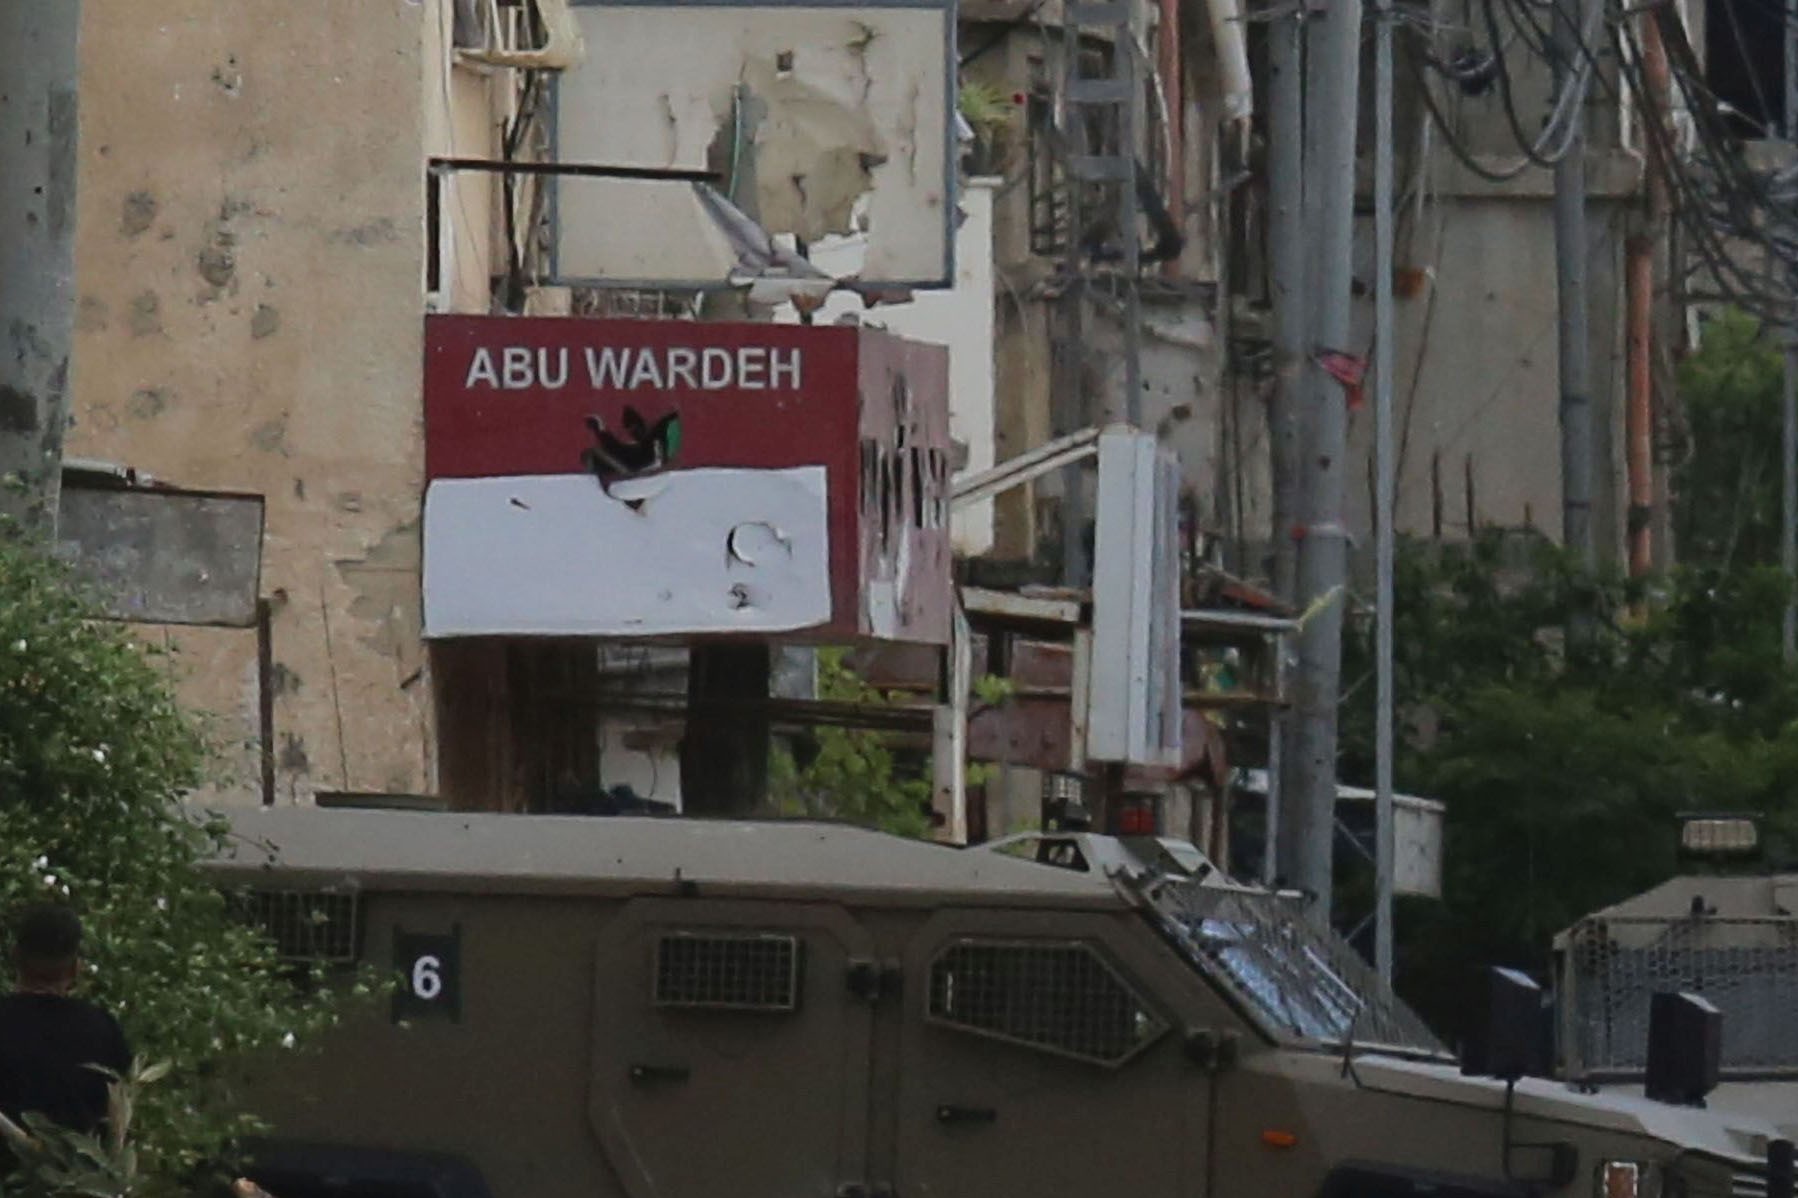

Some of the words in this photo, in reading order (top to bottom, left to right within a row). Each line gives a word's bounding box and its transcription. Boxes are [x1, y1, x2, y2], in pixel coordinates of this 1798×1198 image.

[465, 347, 568, 389] ABU
[585, 347, 801, 389] WARDEH
[412, 955, 441, 999] 6
